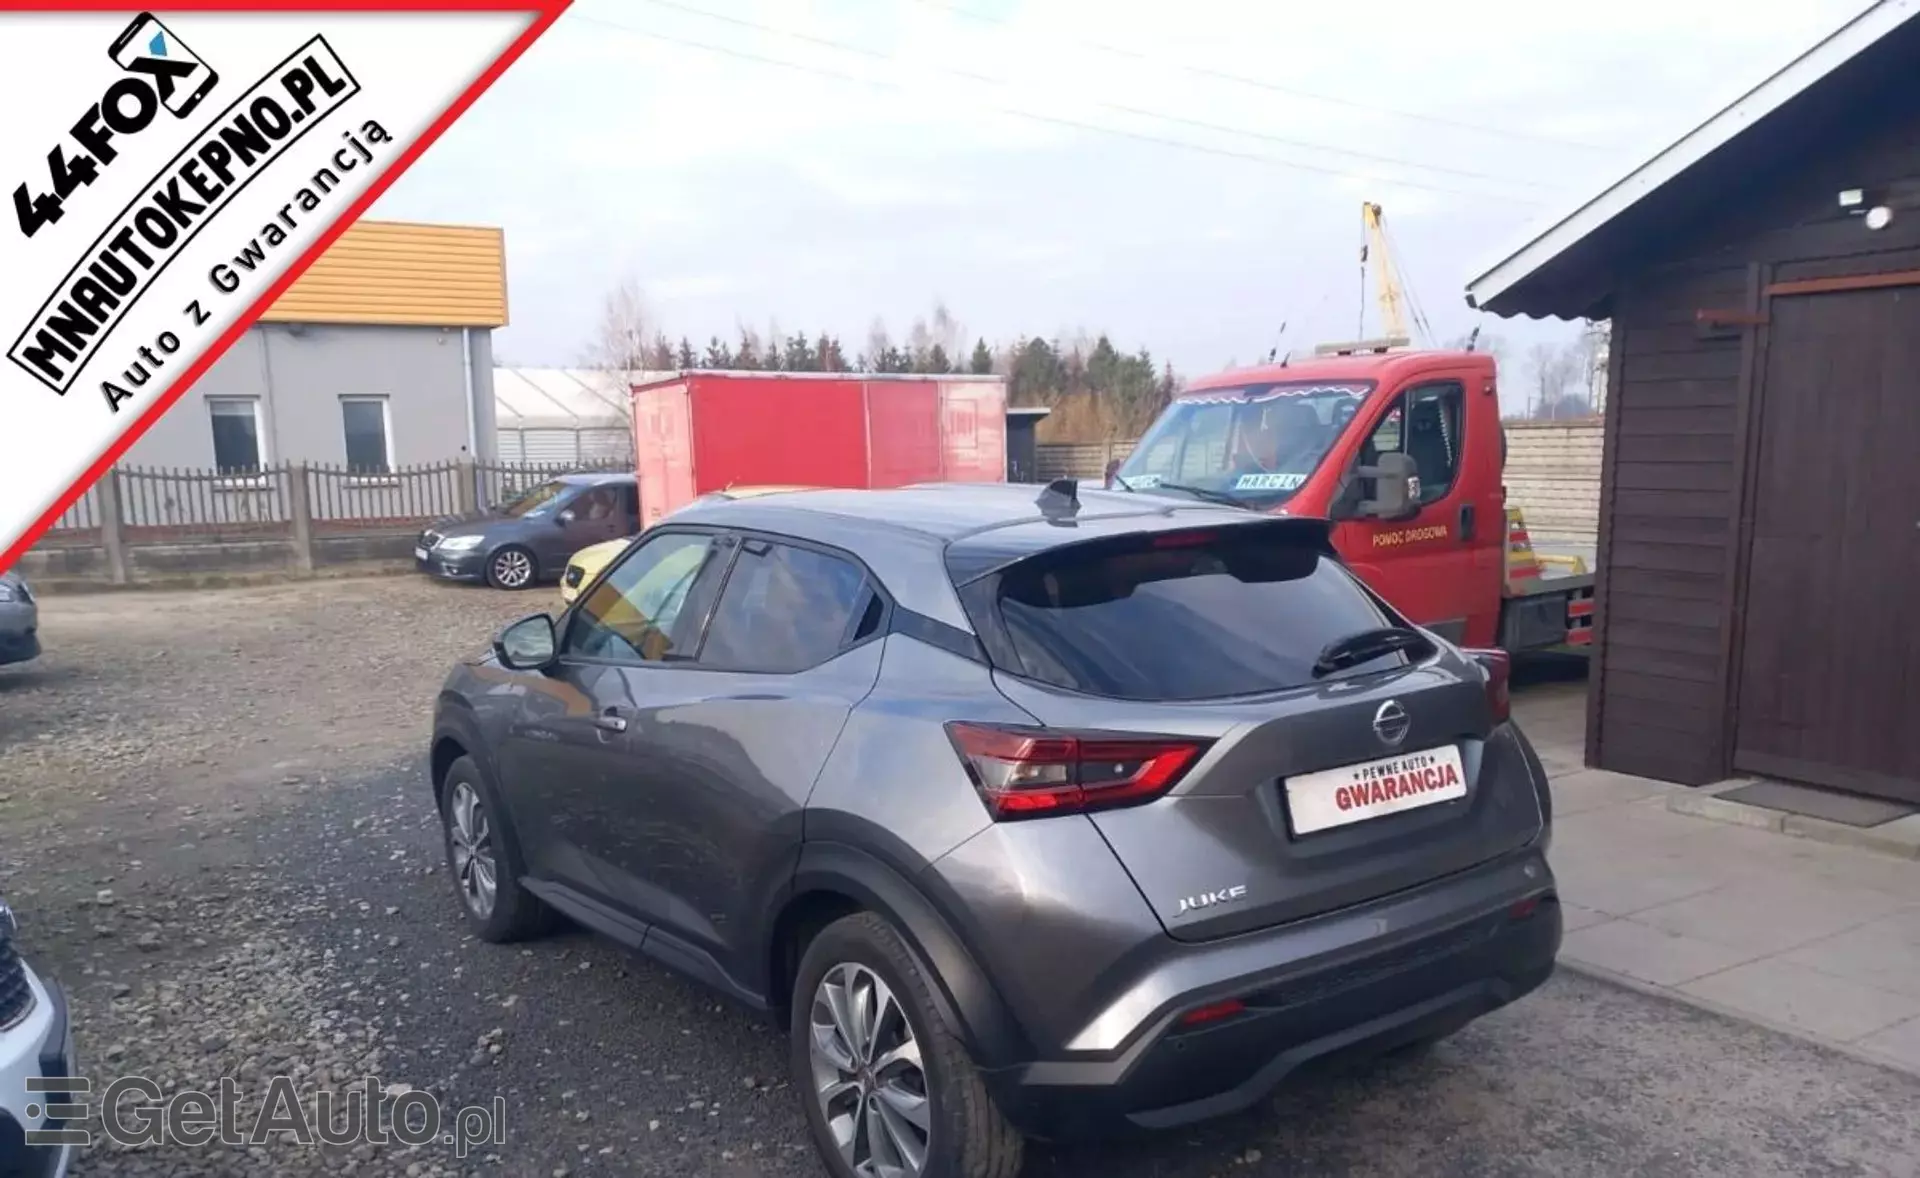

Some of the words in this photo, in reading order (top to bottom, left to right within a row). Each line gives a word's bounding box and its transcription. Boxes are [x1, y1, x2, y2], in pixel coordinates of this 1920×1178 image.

[1362, 762, 1400, 780] PEWNE
[1402, 755, 1428, 771] AUTO
[1335, 763, 1459, 811] GWARANCJA
[1172, 885, 1247, 917] JUKE
